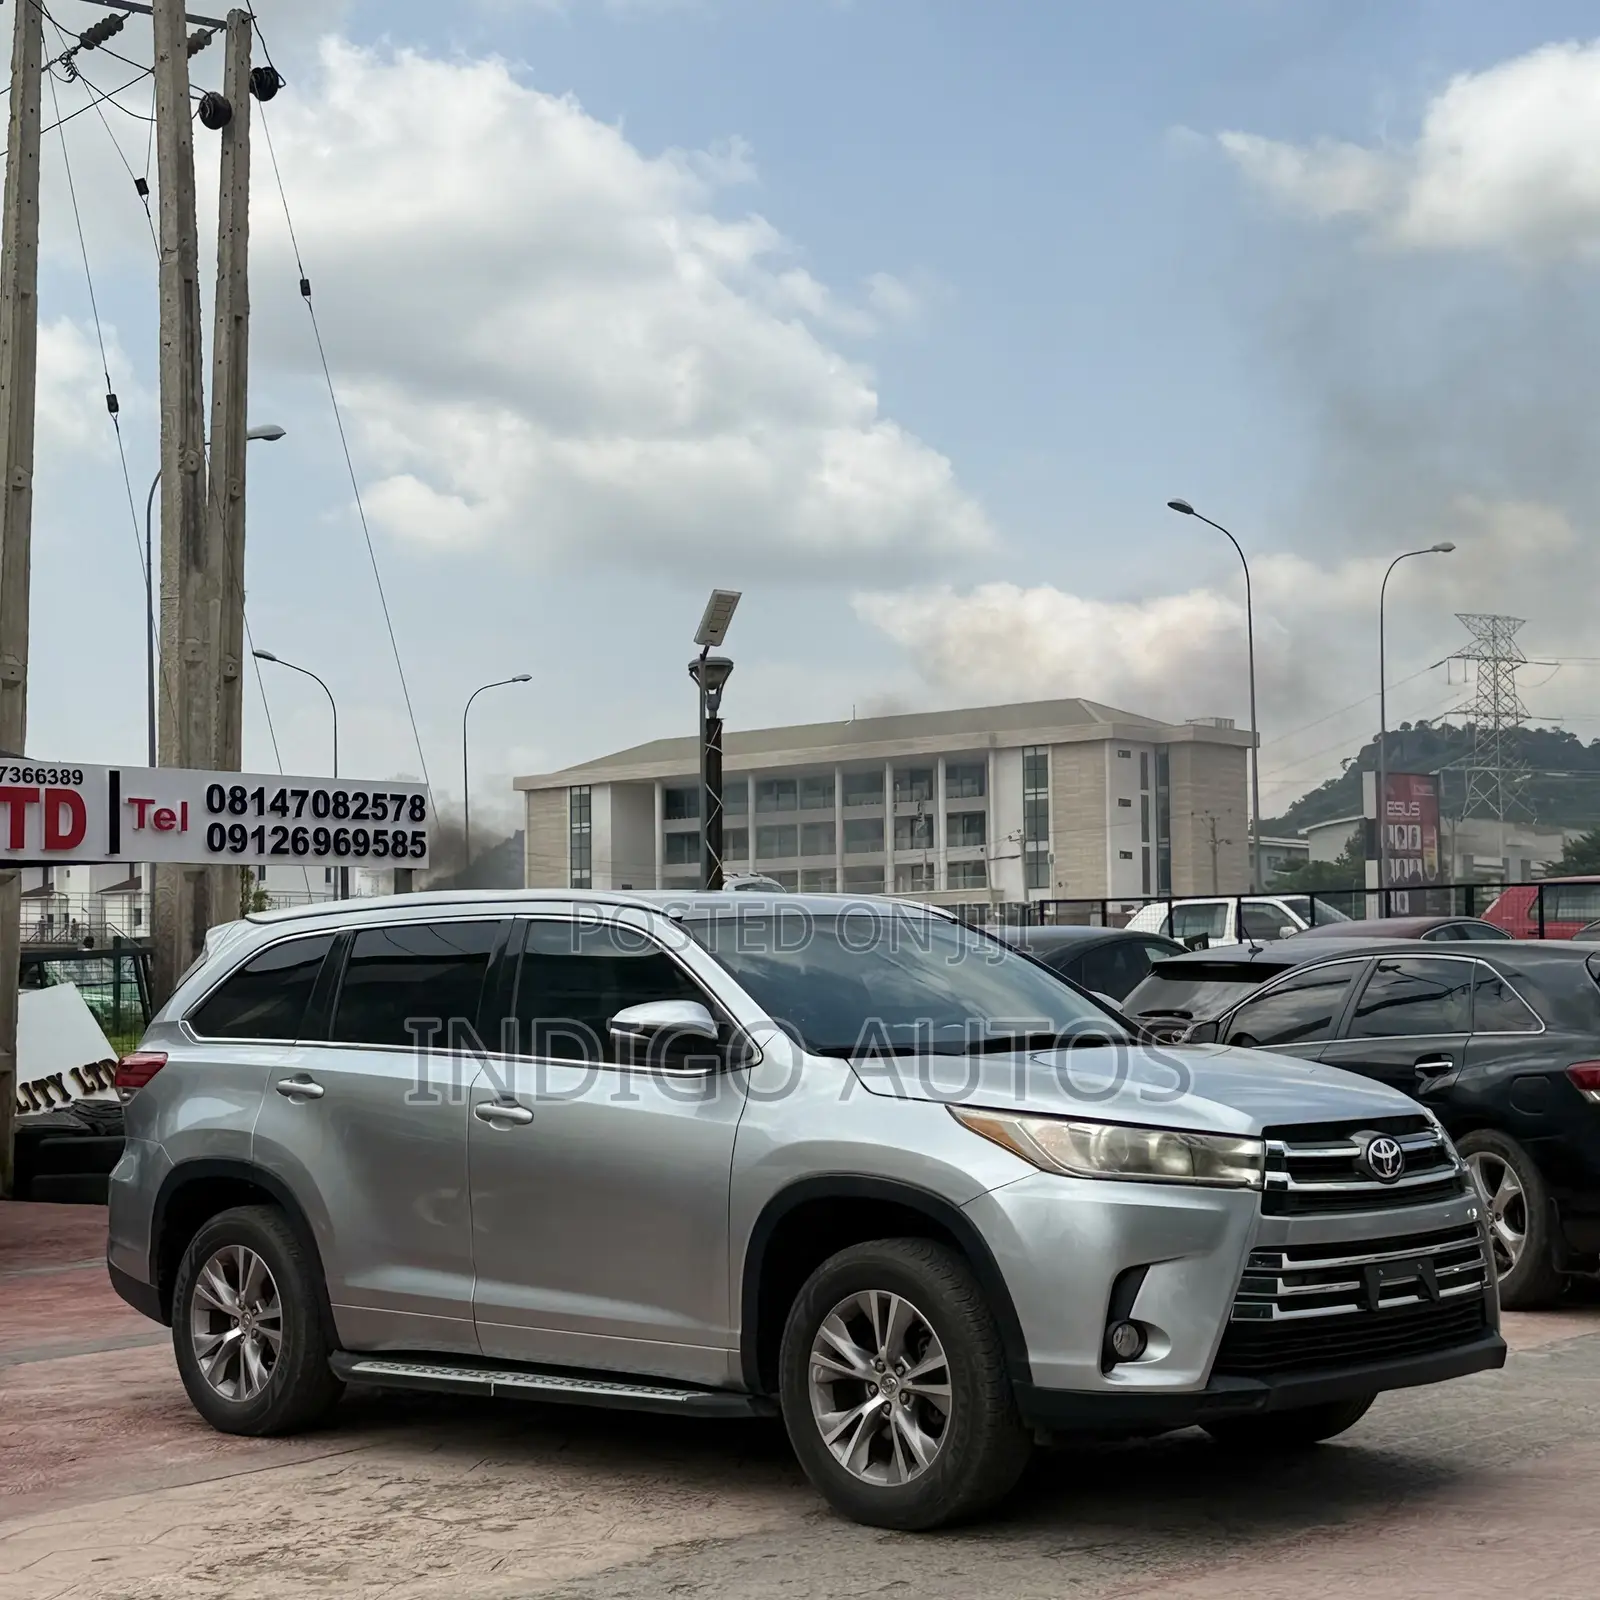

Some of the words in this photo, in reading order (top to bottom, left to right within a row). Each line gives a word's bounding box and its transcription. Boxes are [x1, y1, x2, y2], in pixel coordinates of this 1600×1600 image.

[0, 766, 84, 785] 7366389
[0, 786, 87, 850] TD
[127, 797, 189, 832] Tel
[206, 783, 427, 822] 08147082578
[1386, 800, 1421, 816] ESUS
[206, 822, 428, 859] 09126969585
